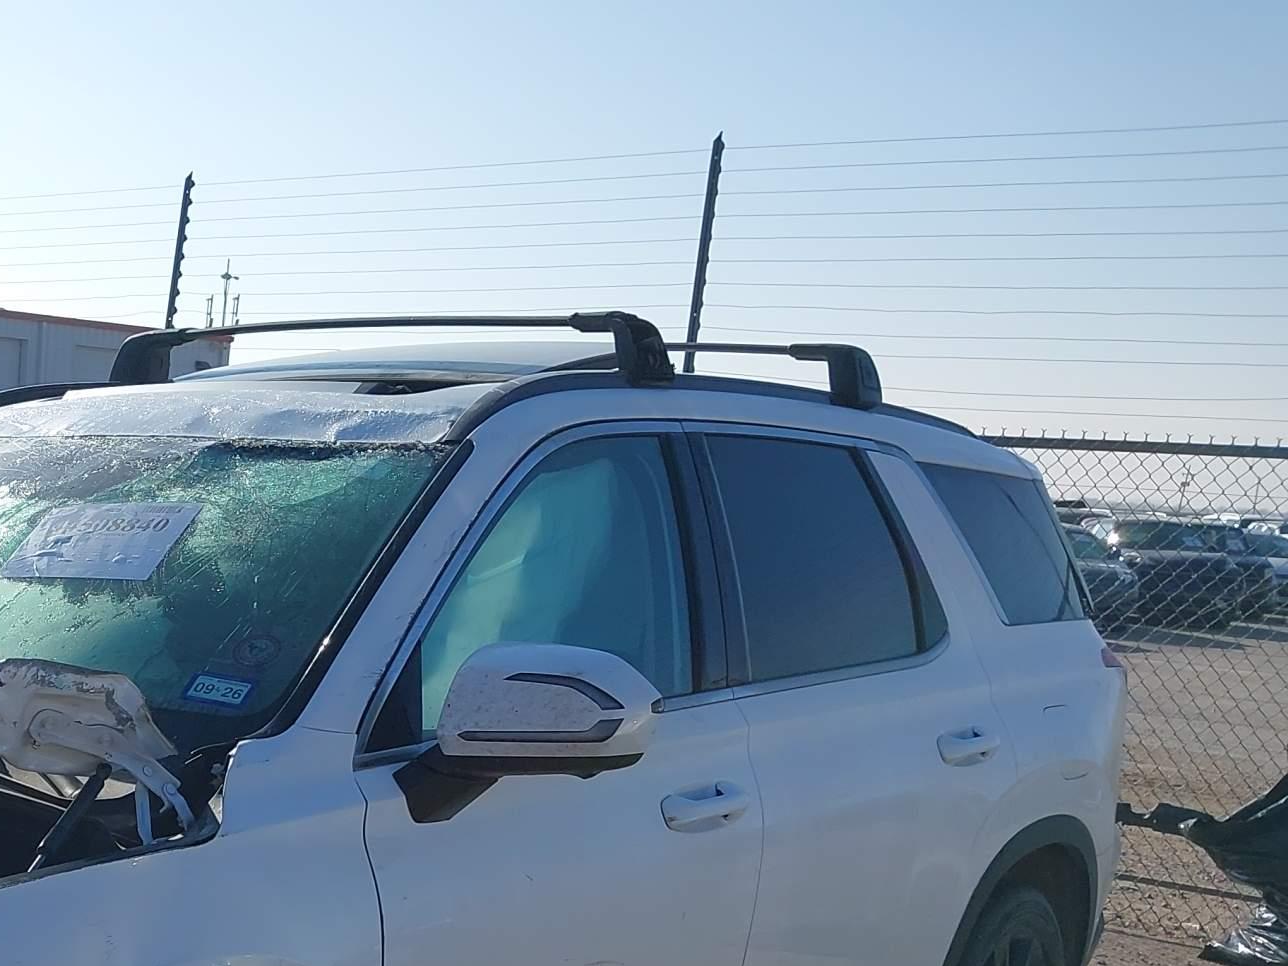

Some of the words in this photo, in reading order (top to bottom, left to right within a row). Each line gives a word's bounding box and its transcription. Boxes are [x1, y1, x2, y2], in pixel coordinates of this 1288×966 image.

[52, 517, 170, 534] 508840
[193, 682, 216, 695] 09
[220, 686, 244, 700] 26
